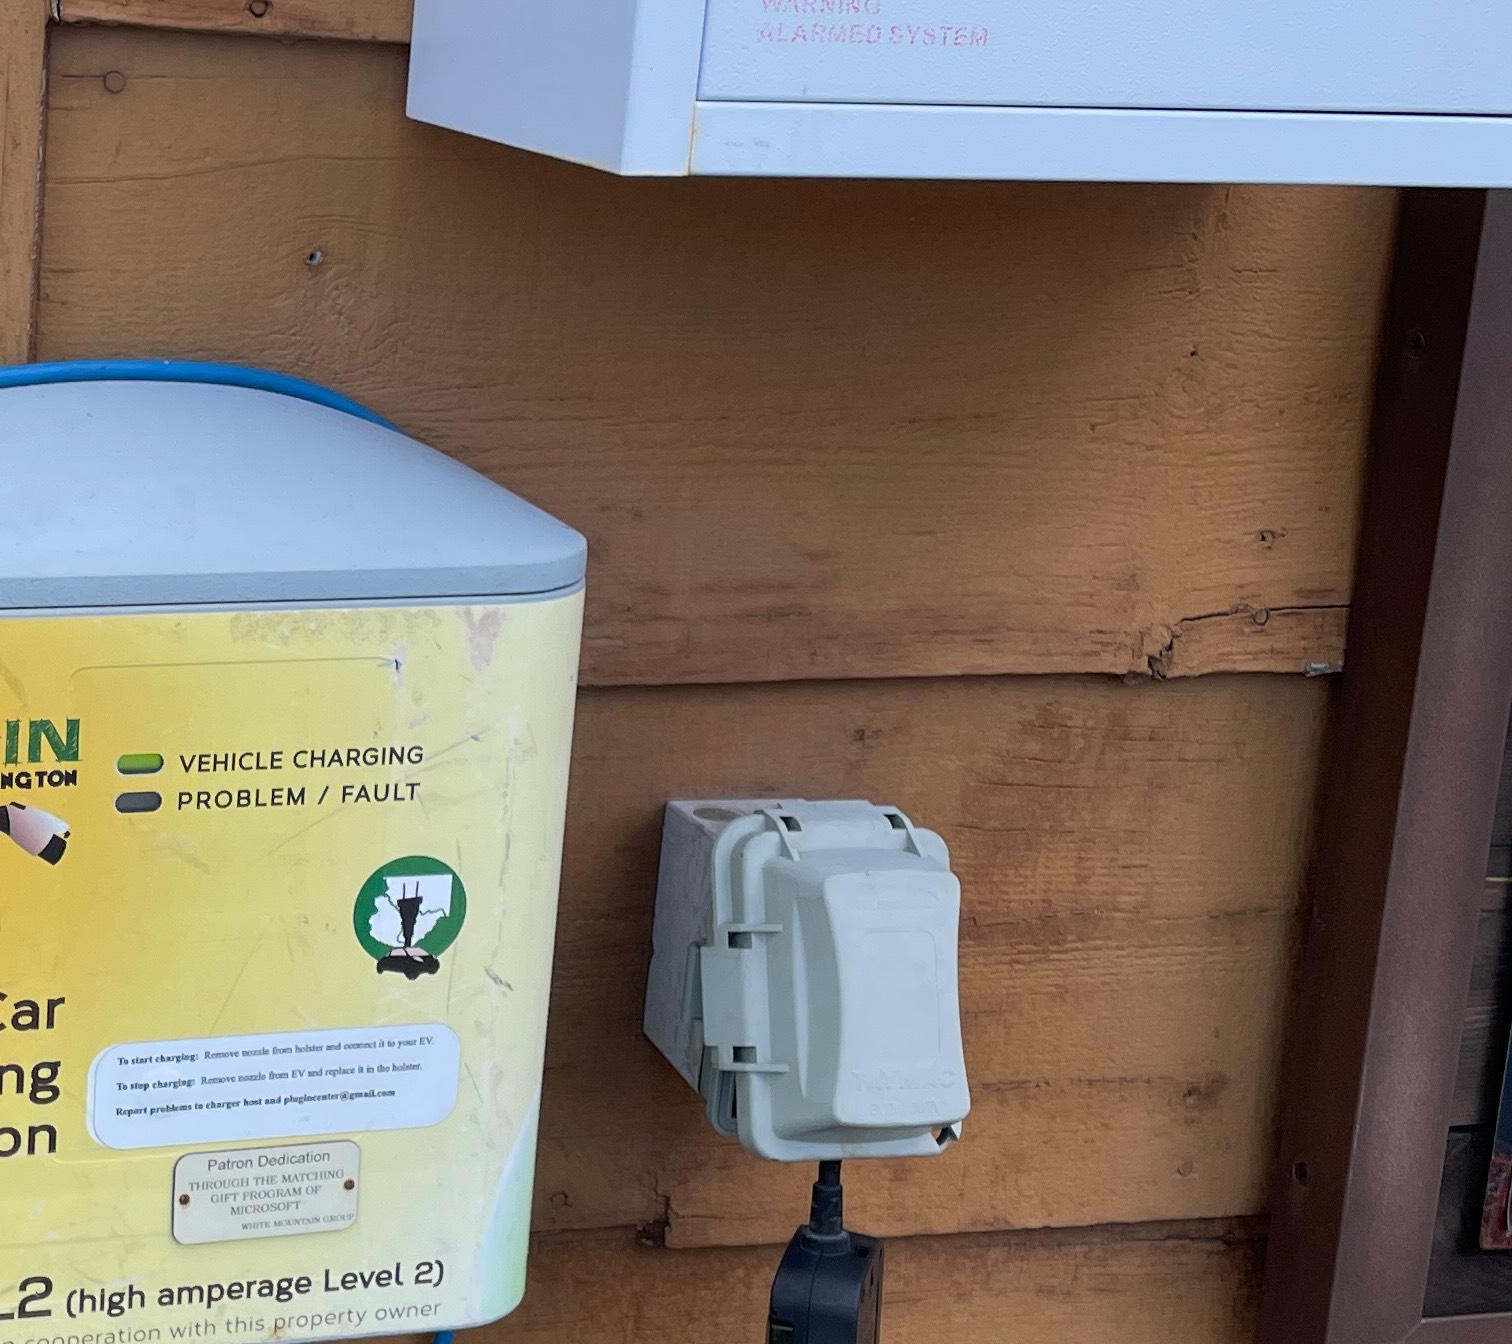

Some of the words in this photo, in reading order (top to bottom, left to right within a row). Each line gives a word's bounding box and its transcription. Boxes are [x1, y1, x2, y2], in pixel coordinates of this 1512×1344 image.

[759, 23, 882, 45] ALARMED
[888, 25, 989, 47] SYSTEM
[179, 751, 284, 773] VEHICLE
[292, 745, 424, 769] CHARGING
[177, 787, 306, 811] PROBLEM
[341, 782, 421, 804] FAULT
[117, 1057, 129, 1066] To
[131, 1056, 153, 1065] start
[204, 1050, 239, 1060] Remove
[116, 1082, 128, 1091] To
[130, 1080, 150, 1091] stop
[201, 1076, 236, 1086] Remove
[291, 1069, 305, 1078] EV
[325, 1066, 355, 1078] replace
[116, 1106, 147, 1117] Report
[150, 1103, 192, 1116] problems
[206, 1099, 240, 1110] charger
[243, 1097, 262, 1106] host
[207, 1157, 253, 1171] Patron
[258, 1151, 330, 1168] Dedication
[188, 1177, 250, 1192] THROUGH
[253, 1174, 278, 1186] THE
[282, 1169, 345, 1184] MATCHING
[210, 1192, 239, 1204] GIFT
[242, 1187, 302, 1201] PROGRAM
[305, 1184, 322, 1195] OF
[230, 1200, 301, 1217] MICROSOFT
[241, 1221, 271, 1231] WHITE
[273, 1216, 320, 1228] MOUNTAIN
[66, 1284, 146, 1318] (high
[157, 1275, 312, 1309] amperage
[324, 1262, 404, 1293] Level
[414, 1259, 445, 1288] 2)
[170, 1320, 216, 1341] with
[225, 1316, 265, 1333] this
[273, 1309, 368, 1339] property
[375, 1303, 441, 1321] owner
